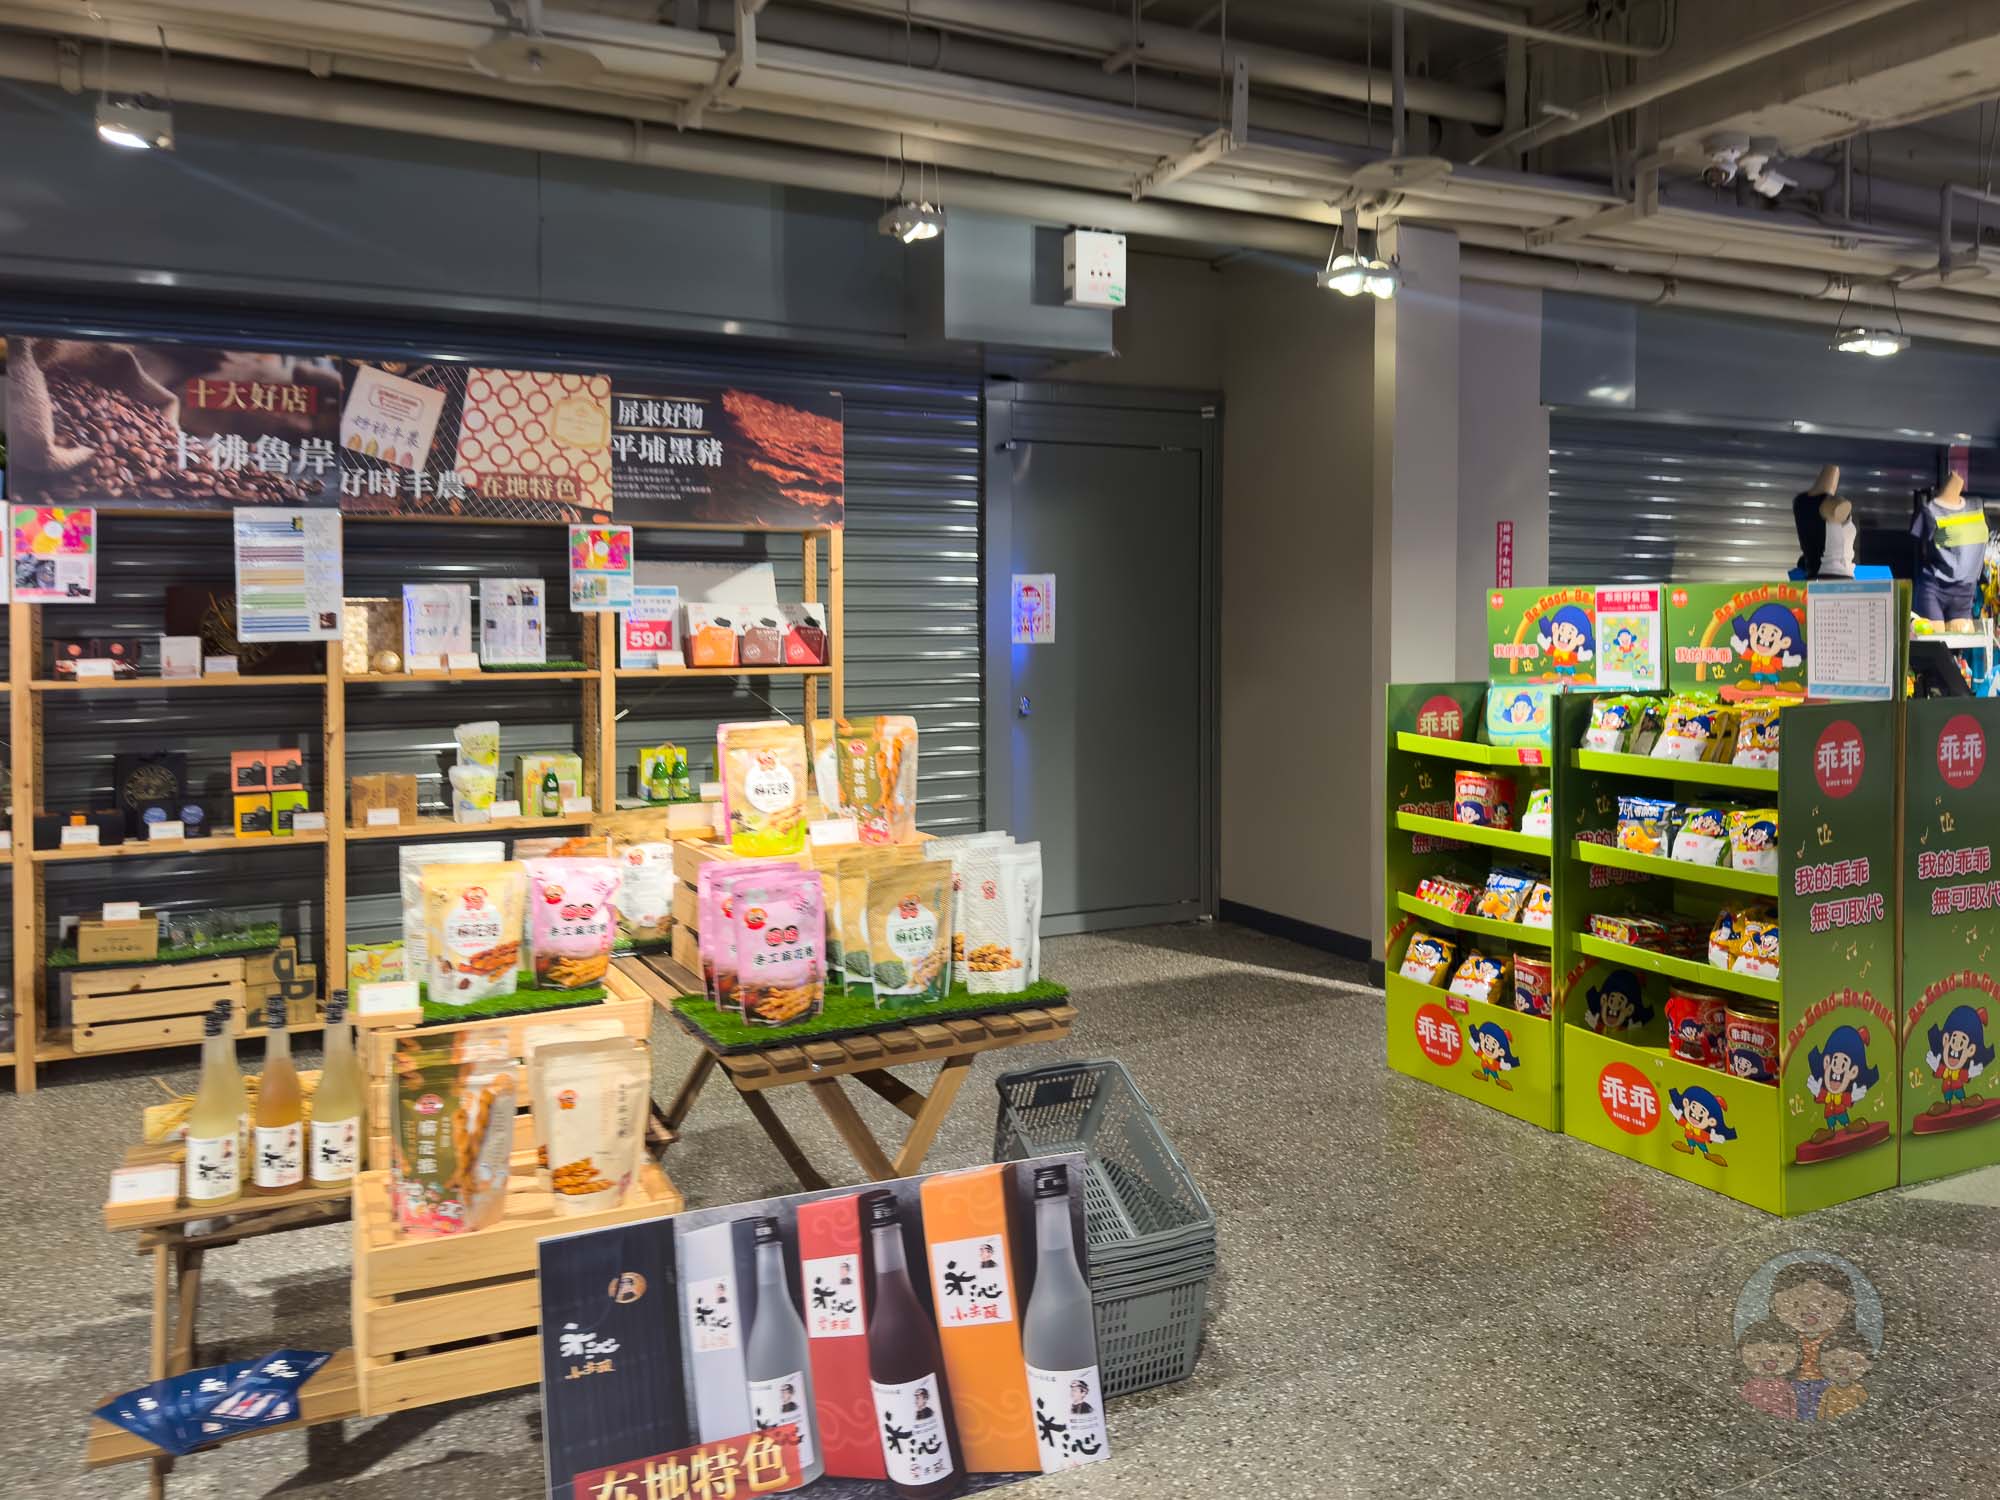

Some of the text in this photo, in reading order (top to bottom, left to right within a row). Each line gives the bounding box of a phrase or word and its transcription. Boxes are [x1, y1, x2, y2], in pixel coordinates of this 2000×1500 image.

[189, 378, 309, 413] 十大好店
[619, 400, 703, 429] 屏東好物
[612, 434, 723, 467] 平埔黑豬
[481, 475, 577, 500] 在地特色
[629, 630, 668, 648] 590
[1420, 710, 1460, 738] 乖乖
[1817, 739, 1861, 778] 乖乖
[1940, 733, 1982, 768] 乖乖
[1795, 857, 1870, 896] 我的乖乖
[1919, 847, 1991, 880] 我的乖乖
[1811, 893, 1884, 932] 無可取代
[1924, 971, 1957, 1006] Good
[1804, 991, 1837, 1028] Good
[1417, 1015, 1461, 1053] 乖乖
[1602, 1075, 1657, 1120] 乖乖
